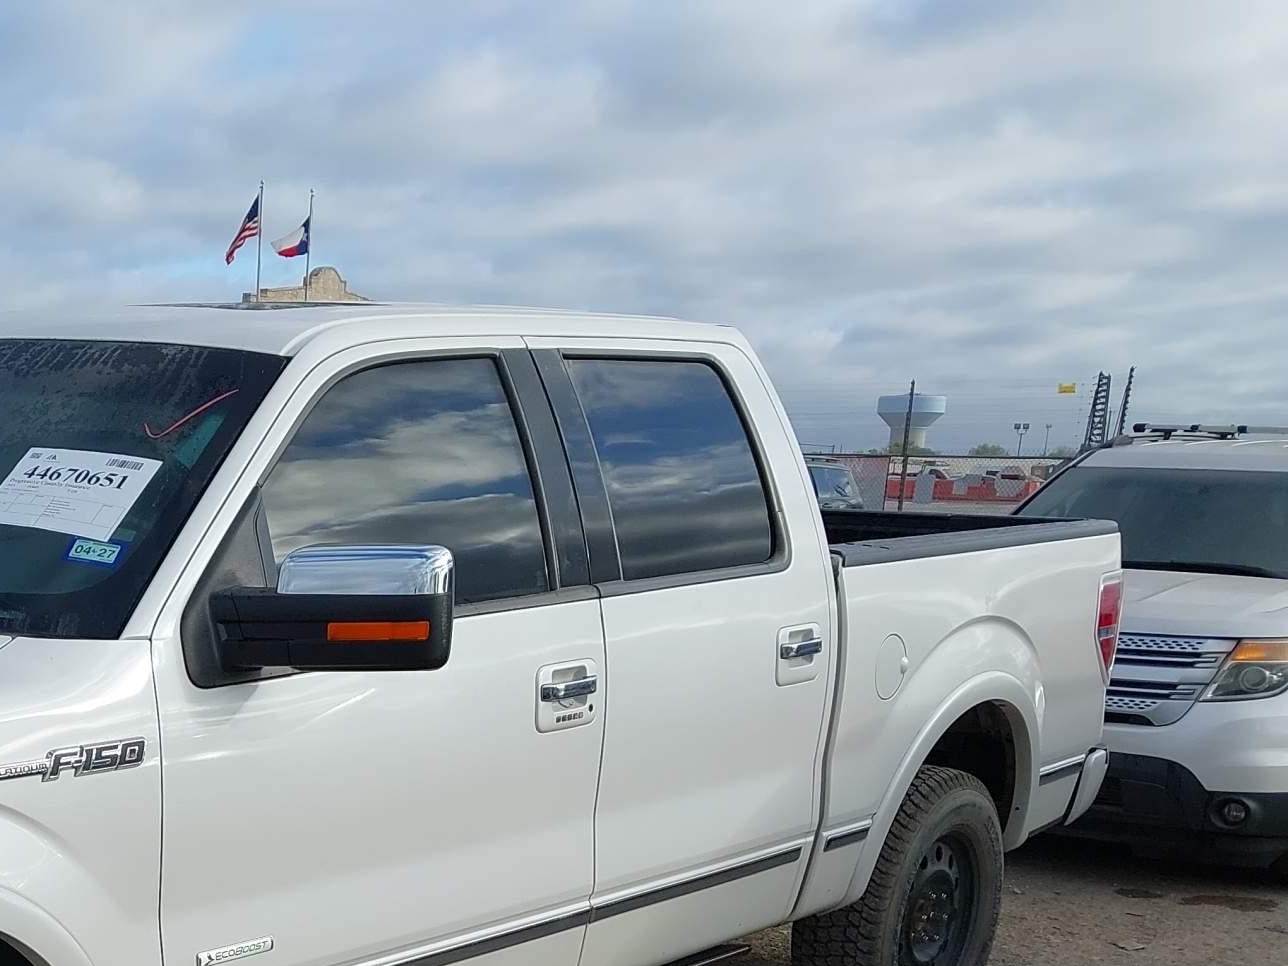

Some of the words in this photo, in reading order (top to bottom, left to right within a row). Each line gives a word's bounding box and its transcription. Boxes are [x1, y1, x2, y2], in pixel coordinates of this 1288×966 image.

[23, 464, 129, 490] 44670651
[42, 736, 147, 783] F-150
[215, 940, 269, 961] ECOBOOST
